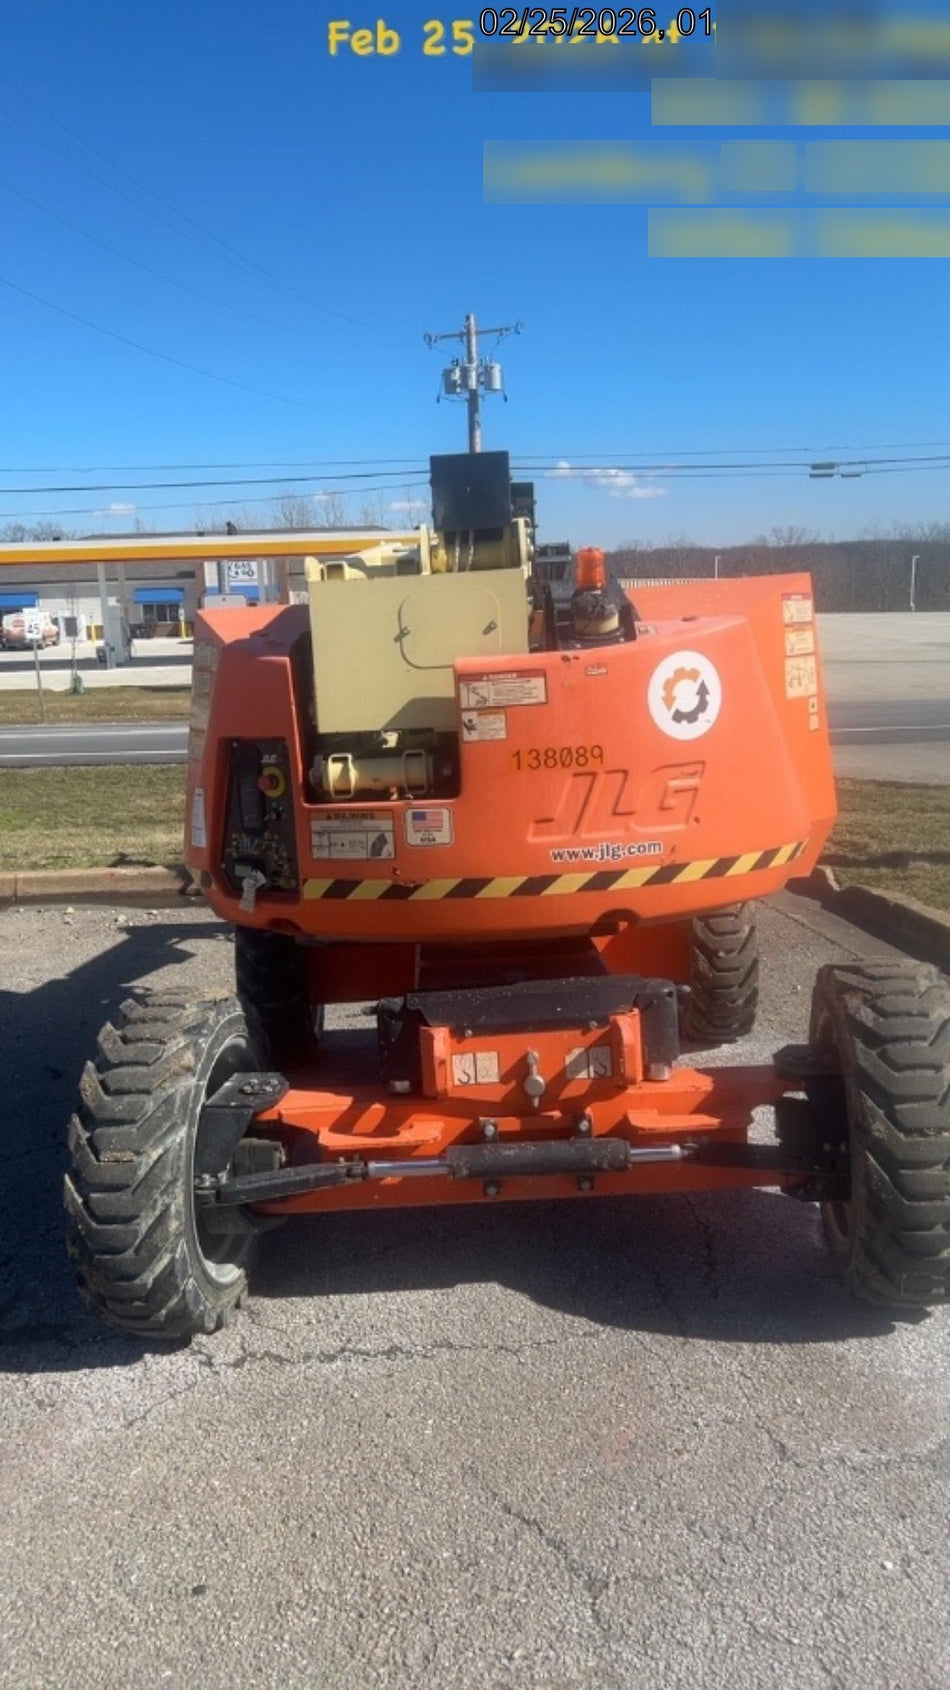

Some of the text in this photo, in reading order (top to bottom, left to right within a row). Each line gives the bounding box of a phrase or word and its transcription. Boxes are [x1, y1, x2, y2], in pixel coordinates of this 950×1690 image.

[512, 745, 604, 770] 138089
[527, 760, 707, 842] JLG
[551, 841, 662, 862] www.jlg.com
